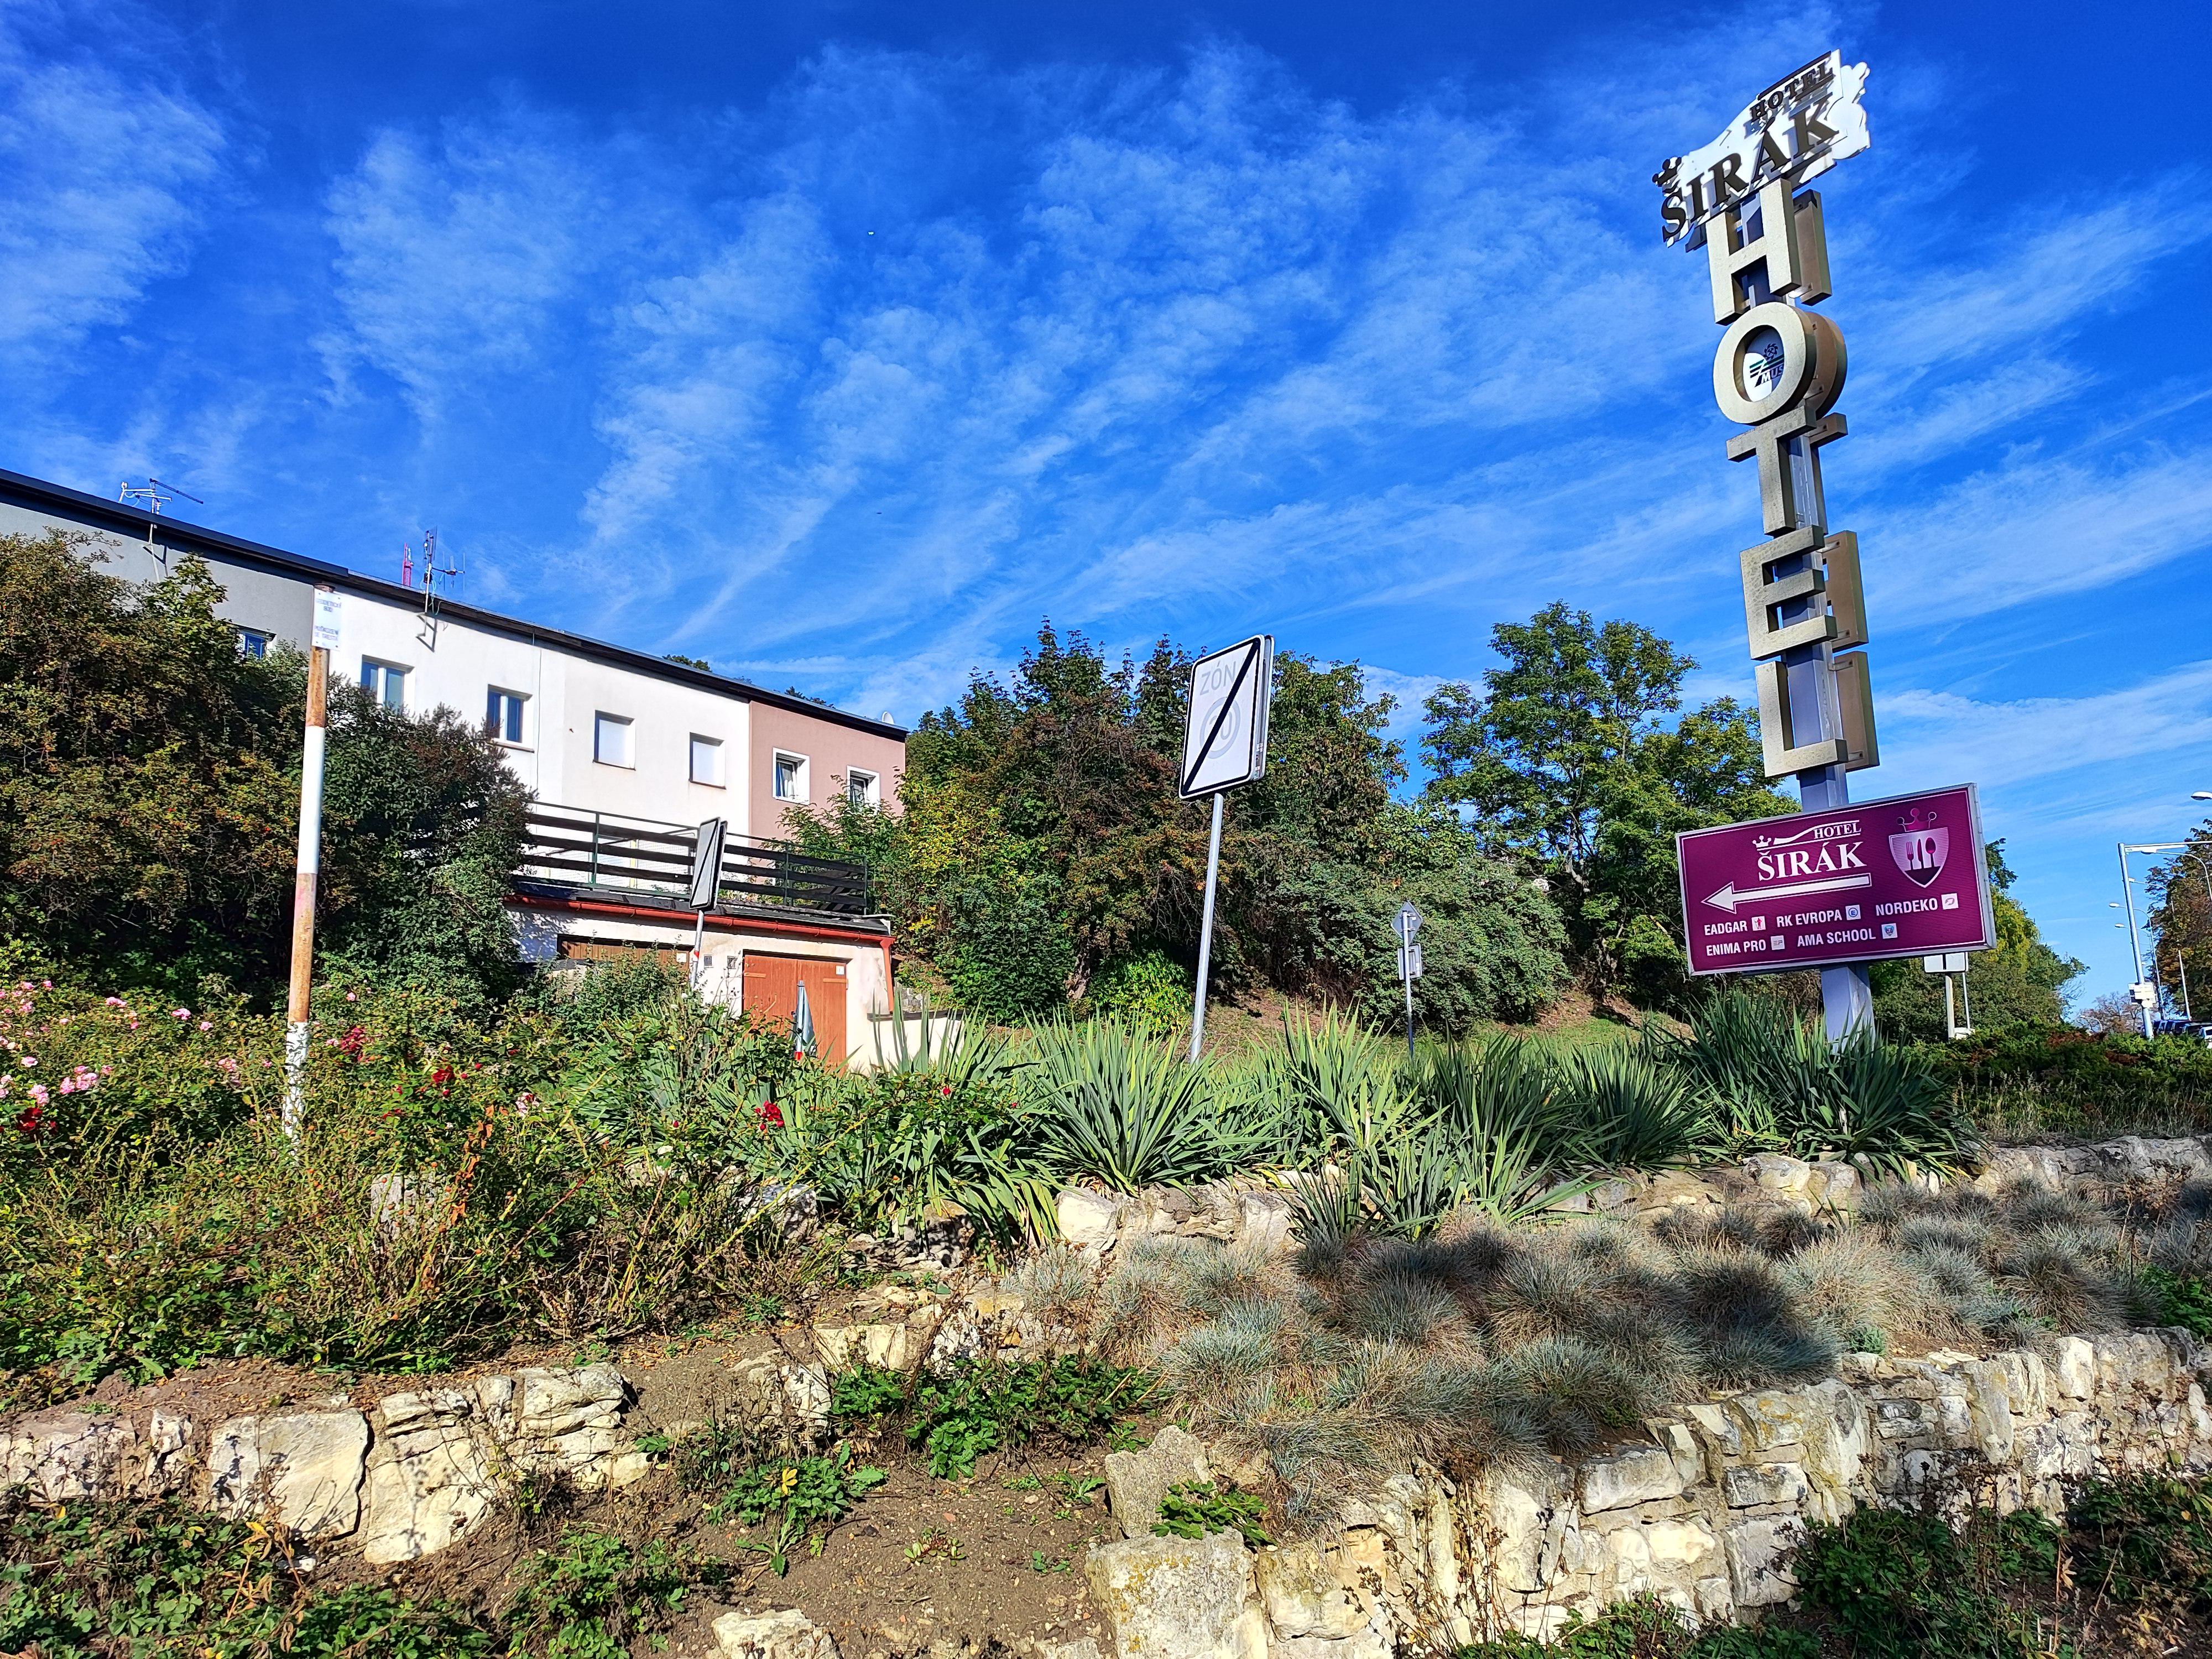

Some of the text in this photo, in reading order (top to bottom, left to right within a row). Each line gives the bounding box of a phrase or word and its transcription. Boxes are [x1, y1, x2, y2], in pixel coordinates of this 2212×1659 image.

[1750, 62, 1835, 121] HOTEL
[1706, 178, 1848, 779] HOTEL
[1813, 822, 1861, 839] HOTEL
[1757, 841, 1867, 881] ŠIRÁK
[1875, 898, 1938, 916] NORDEKO
[1776, 910, 1842, 927] RK EVROPA
[1704, 920, 1747, 936] EADGAR
[1797, 928, 1876, 947] AMA SCHOOL
[1706, 939, 1766, 956] ENIMA PRO
